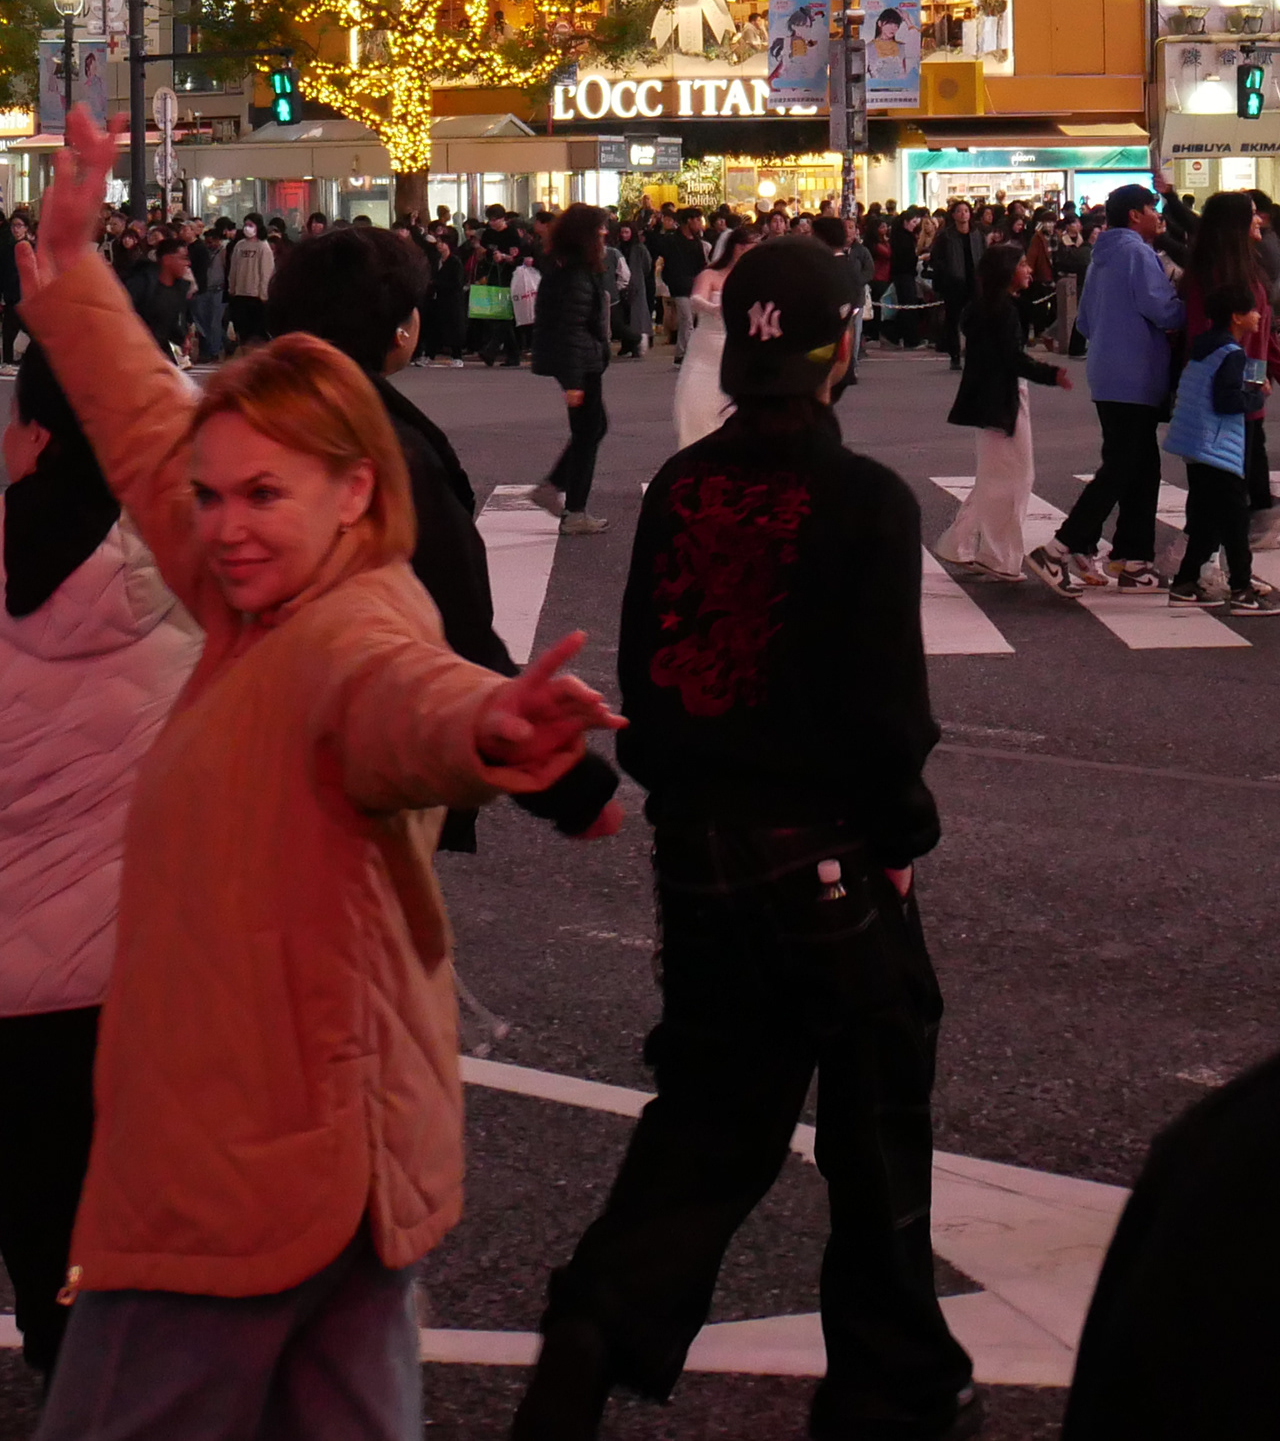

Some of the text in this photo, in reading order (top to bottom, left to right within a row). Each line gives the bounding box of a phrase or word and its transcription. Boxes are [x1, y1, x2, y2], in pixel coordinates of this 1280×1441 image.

[1172, 143, 1232, 154] SHIBUYA
[687, 180, 716, 194] Happy
[685, 194, 718, 207] Holiday
